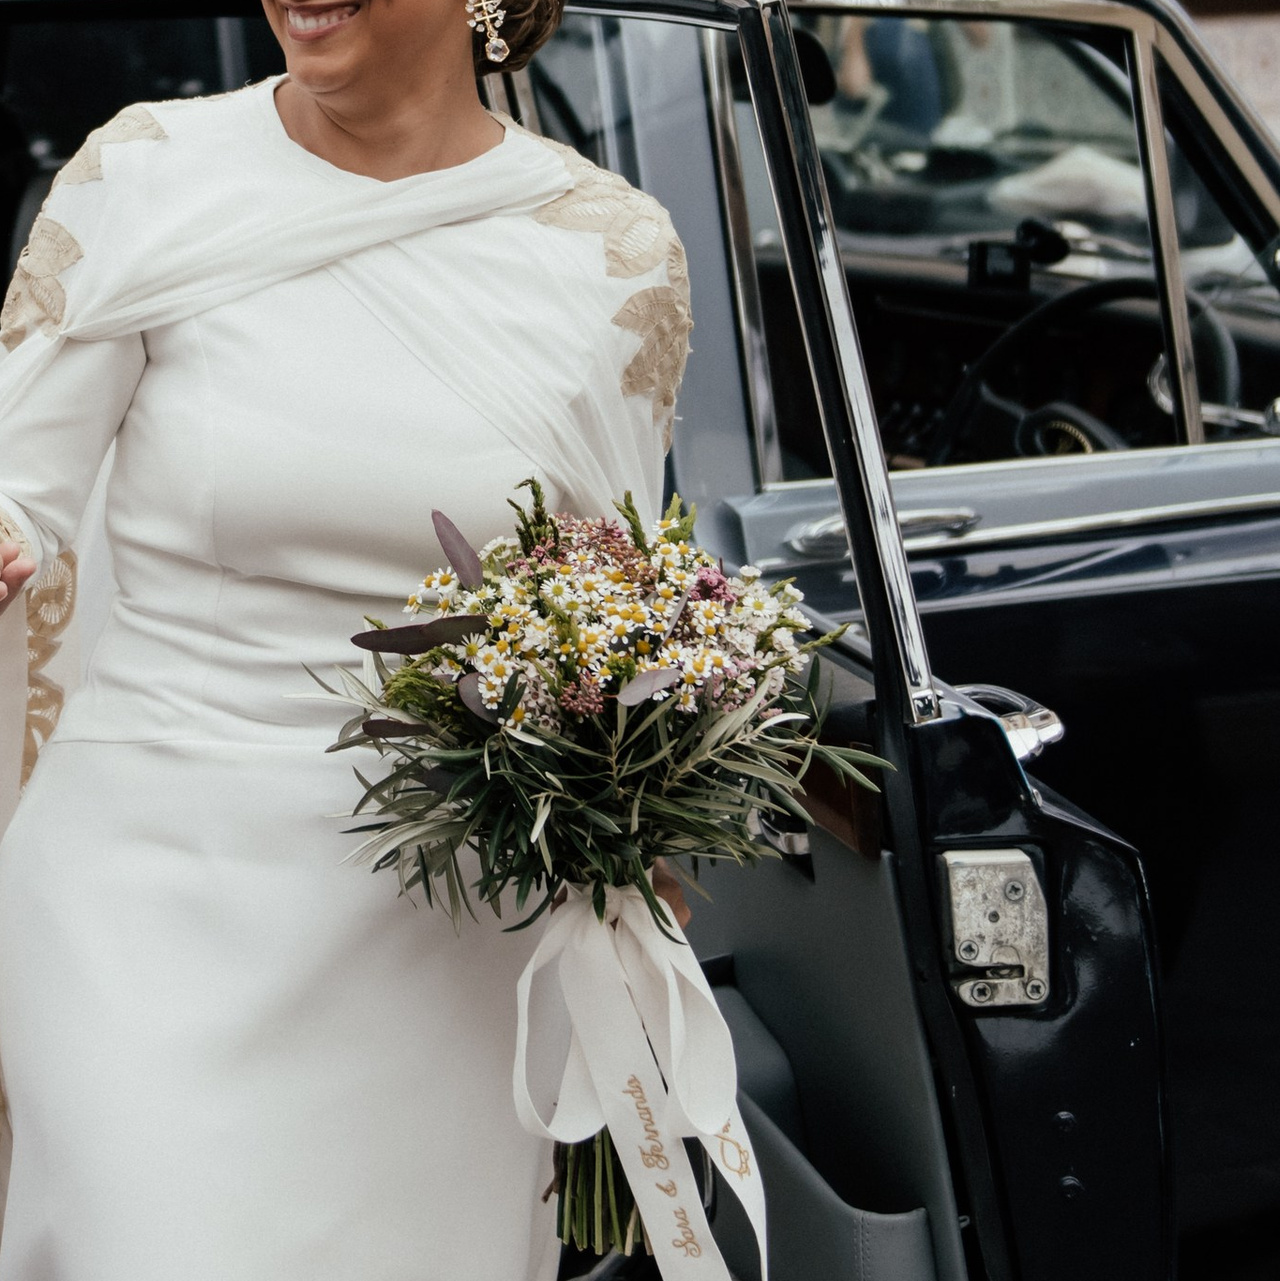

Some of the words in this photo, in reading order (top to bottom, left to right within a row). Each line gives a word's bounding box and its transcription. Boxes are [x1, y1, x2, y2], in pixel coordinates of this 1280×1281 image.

[623, 1074, 669, 1170] Fernando
[656, 1179, 677, 1197] &
[672, 1207, 702, 1258] Sara
